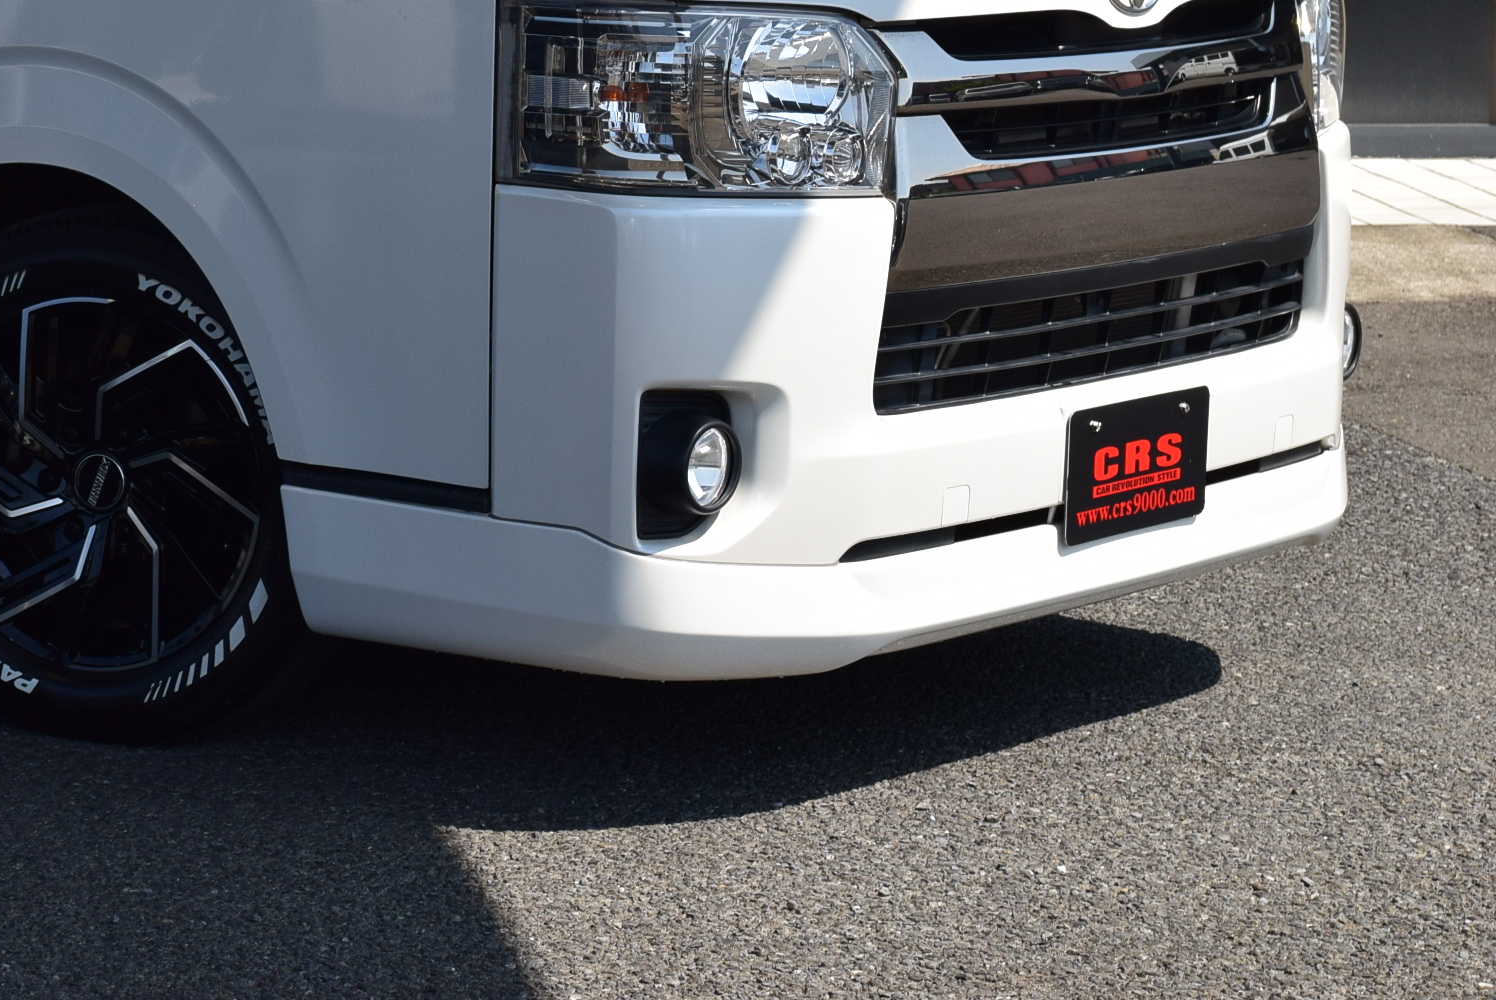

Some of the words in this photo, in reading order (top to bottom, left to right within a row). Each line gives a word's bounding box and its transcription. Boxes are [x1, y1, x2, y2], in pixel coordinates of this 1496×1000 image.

[1093, 433, 1183, 481] CRS
[1096, 485, 1111, 496] CAR
[1112, 475, 1154, 493] REVOLUTION
[1157, 469, 1178, 482] STYLE
[1076, 486, 1196, 527] www.crs9000.com
